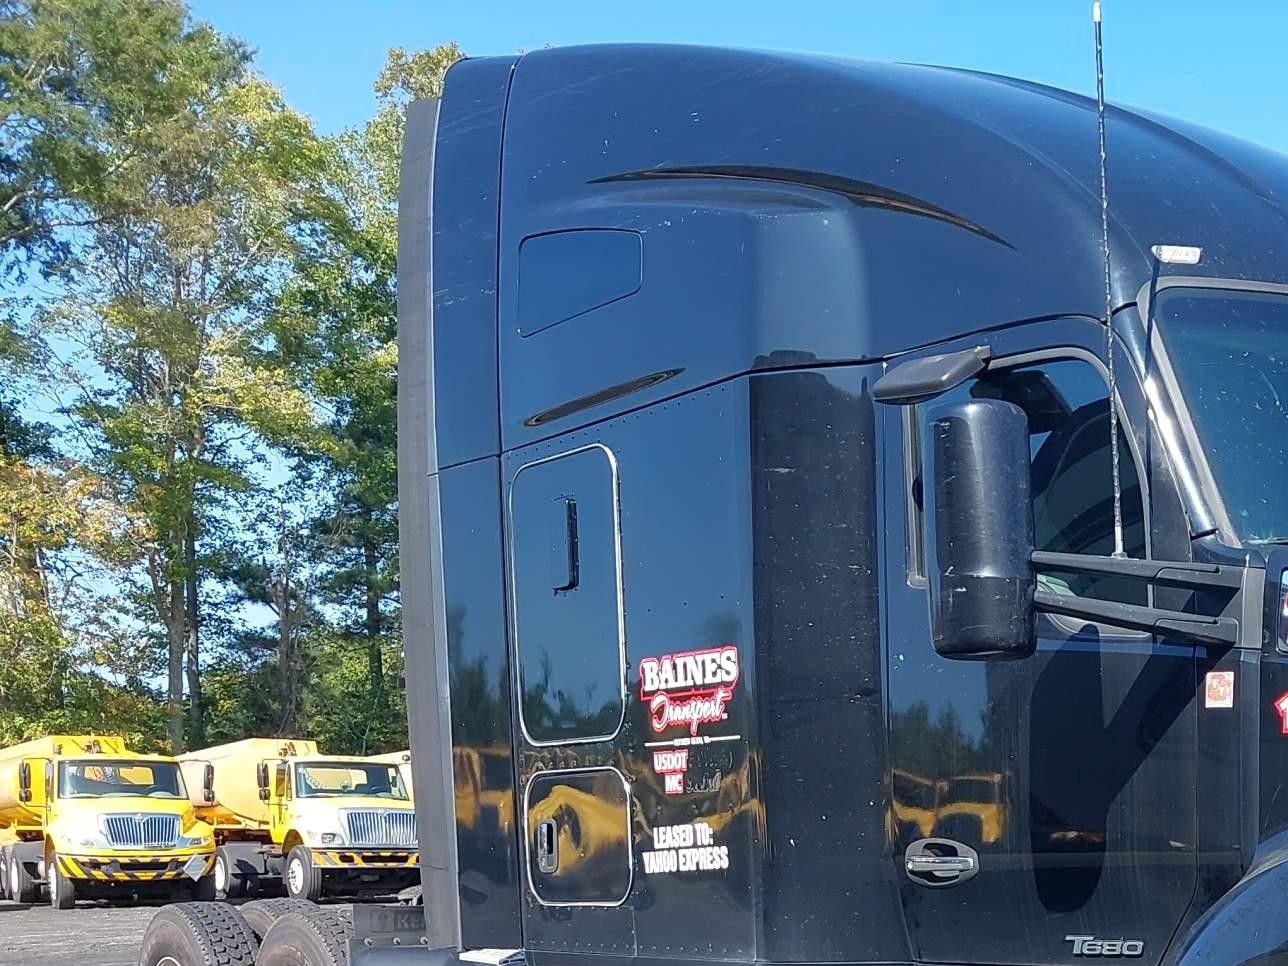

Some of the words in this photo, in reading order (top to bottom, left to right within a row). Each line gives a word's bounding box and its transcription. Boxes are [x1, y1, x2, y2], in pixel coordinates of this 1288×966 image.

[641, 648, 738, 692] BAINES
[653, 751, 688, 772] USDOT
[665, 773, 684, 794] MC
[653, 823, 694, 849] LEASED
[694, 822, 714, 846] TO:
[641, 849, 678, 874] YAHOO
[678, 845, 730, 872] EXPRESS
[1065, 934, 1144, 957] T680
